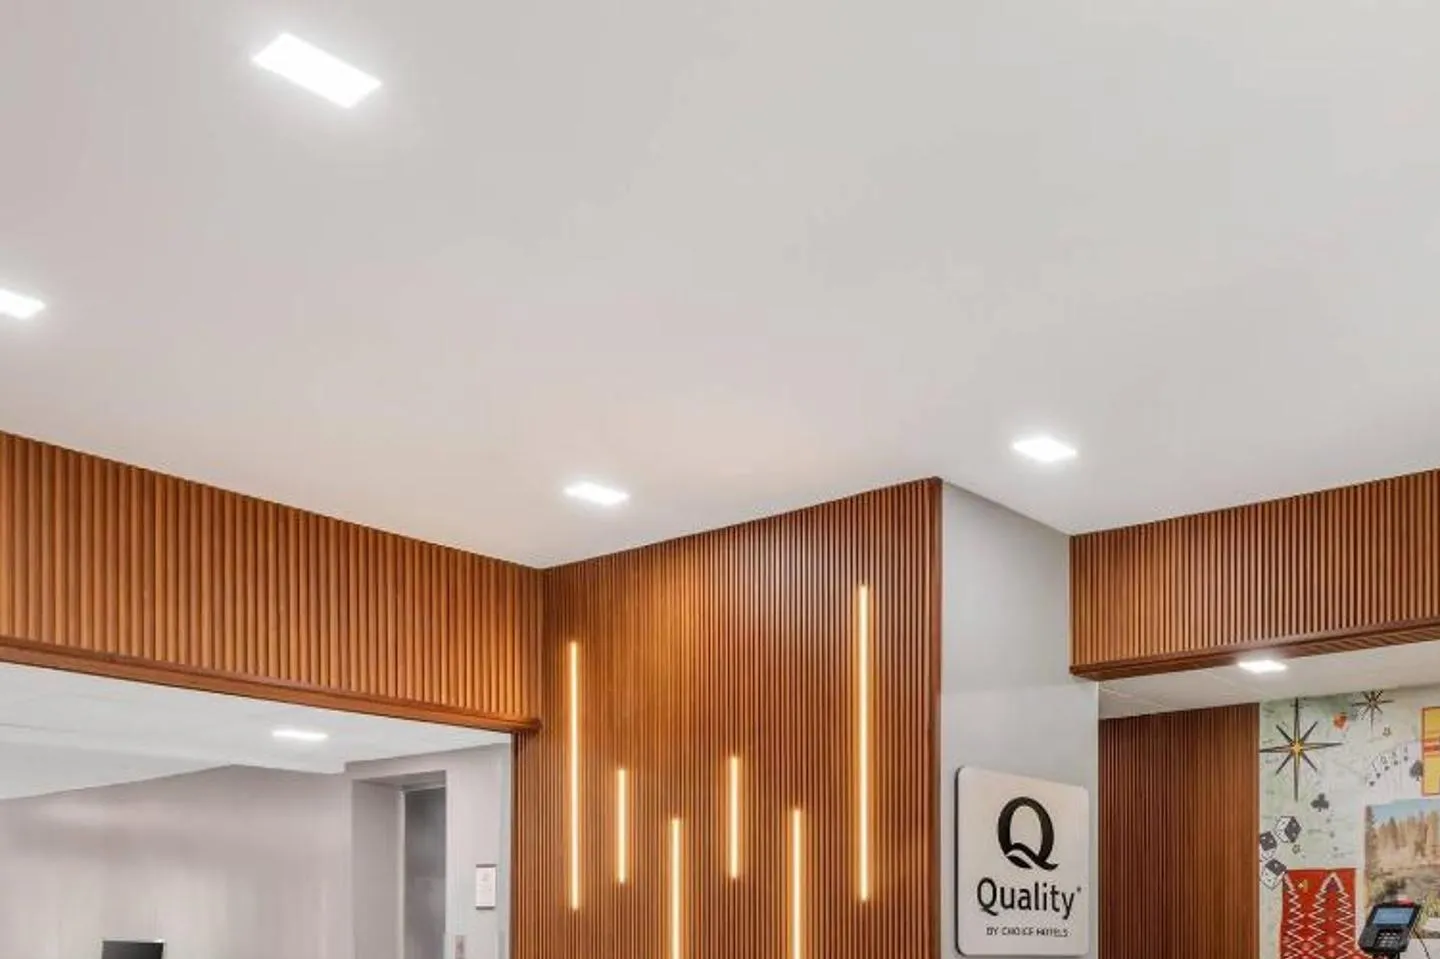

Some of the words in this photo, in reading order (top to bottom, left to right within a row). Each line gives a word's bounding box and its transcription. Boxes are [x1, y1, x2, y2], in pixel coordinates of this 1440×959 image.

[998, 797, 1058, 871] Q
[977, 877, 1075, 920] Quality
[986, 927, 999, 936] BY
